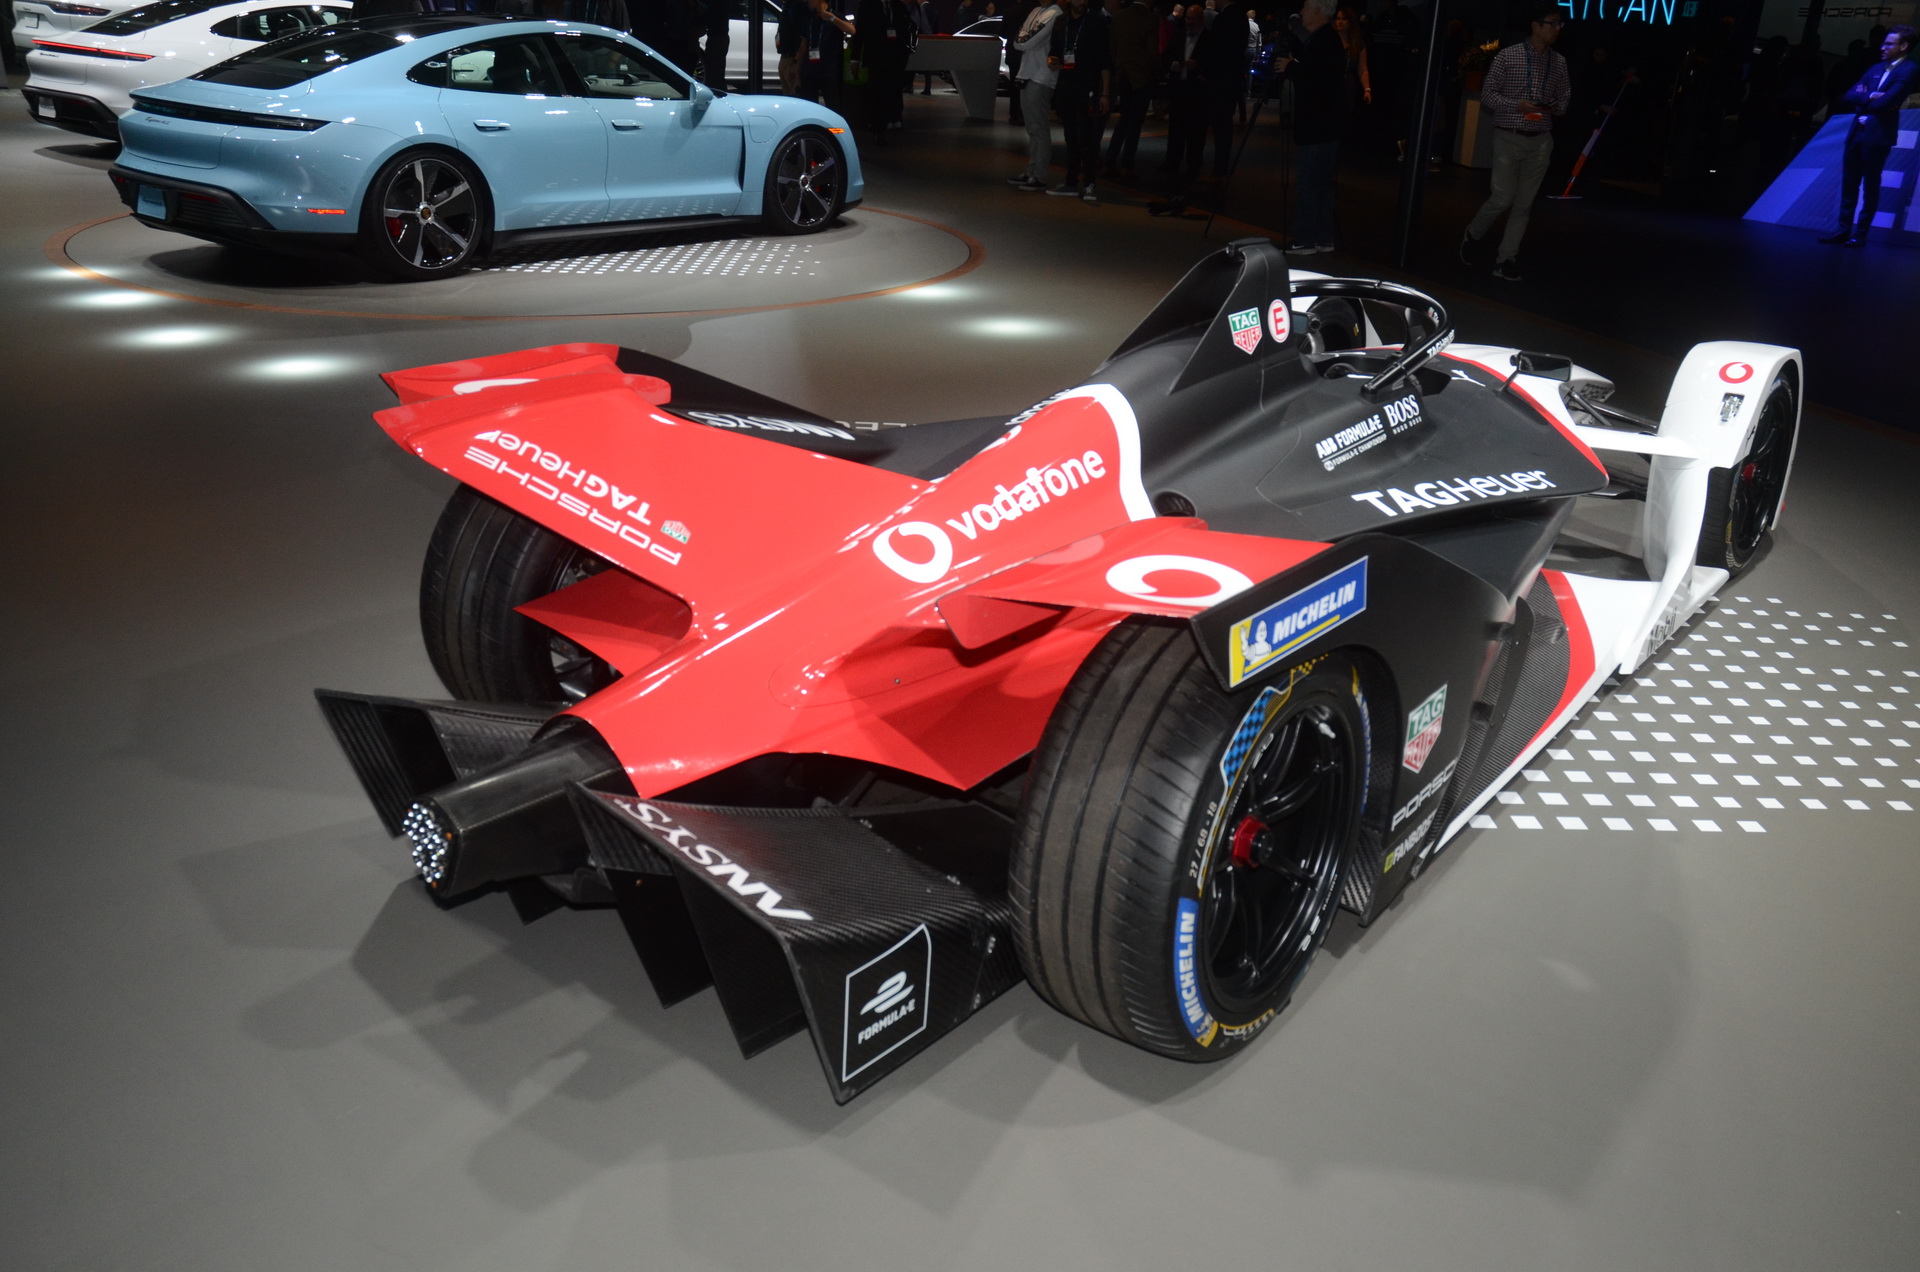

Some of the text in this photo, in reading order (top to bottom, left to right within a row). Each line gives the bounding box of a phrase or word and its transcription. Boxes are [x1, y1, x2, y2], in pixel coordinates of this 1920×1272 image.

[1231, 310, 1258, 330] TAG
[1234, 327, 1261, 351] HEUER
[1383, 394, 1420, 428] BOSS
[1315, 437, 1338, 459] ABB
[463, 446, 682, 566] PORSCHE
[946, 450, 1107, 541] vodafone
[1272, 580, 1357, 645] MICHELIN
[1411, 691, 1444, 737] TAG
[1391, 757, 1457, 832] PORSC
[1178, 911, 1204, 1024] MICHELIN
